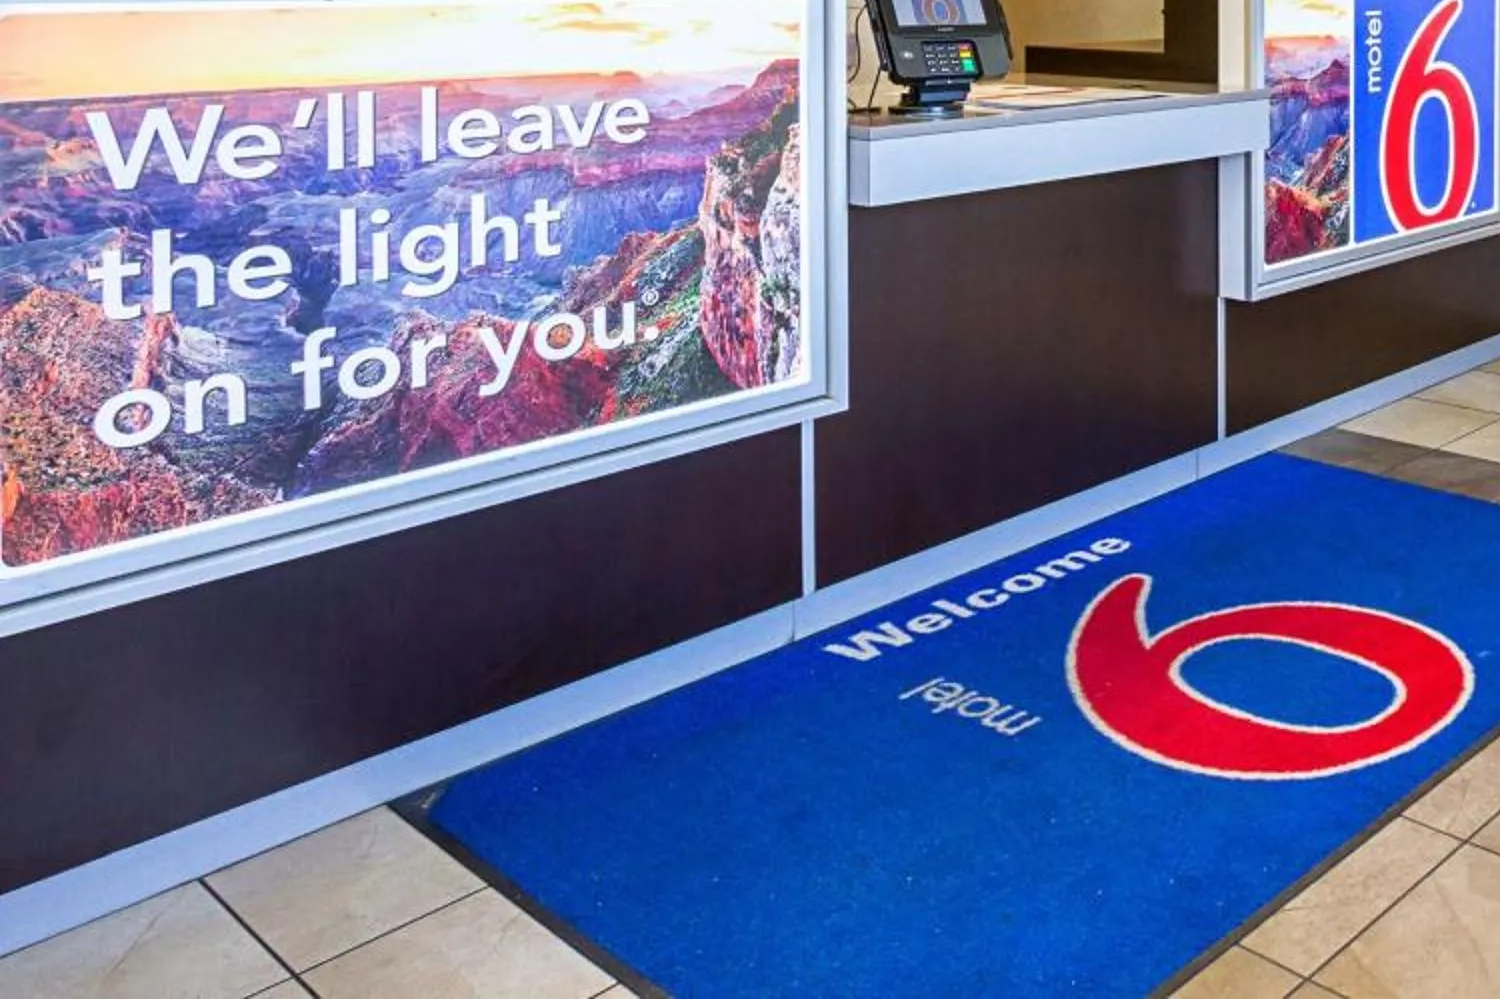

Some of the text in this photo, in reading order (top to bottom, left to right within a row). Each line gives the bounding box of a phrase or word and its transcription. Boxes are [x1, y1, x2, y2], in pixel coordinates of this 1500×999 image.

[1365, 10, 1383, 94] motel
[86, 86, 650, 191] We'll leave
[87, 192, 563, 321] the light
[93, 372, 247, 448] on
[290, 326, 447, 411] for
[823, 534, 1132, 664] Welcome
[898, 572, 1475, 782] motel 6
